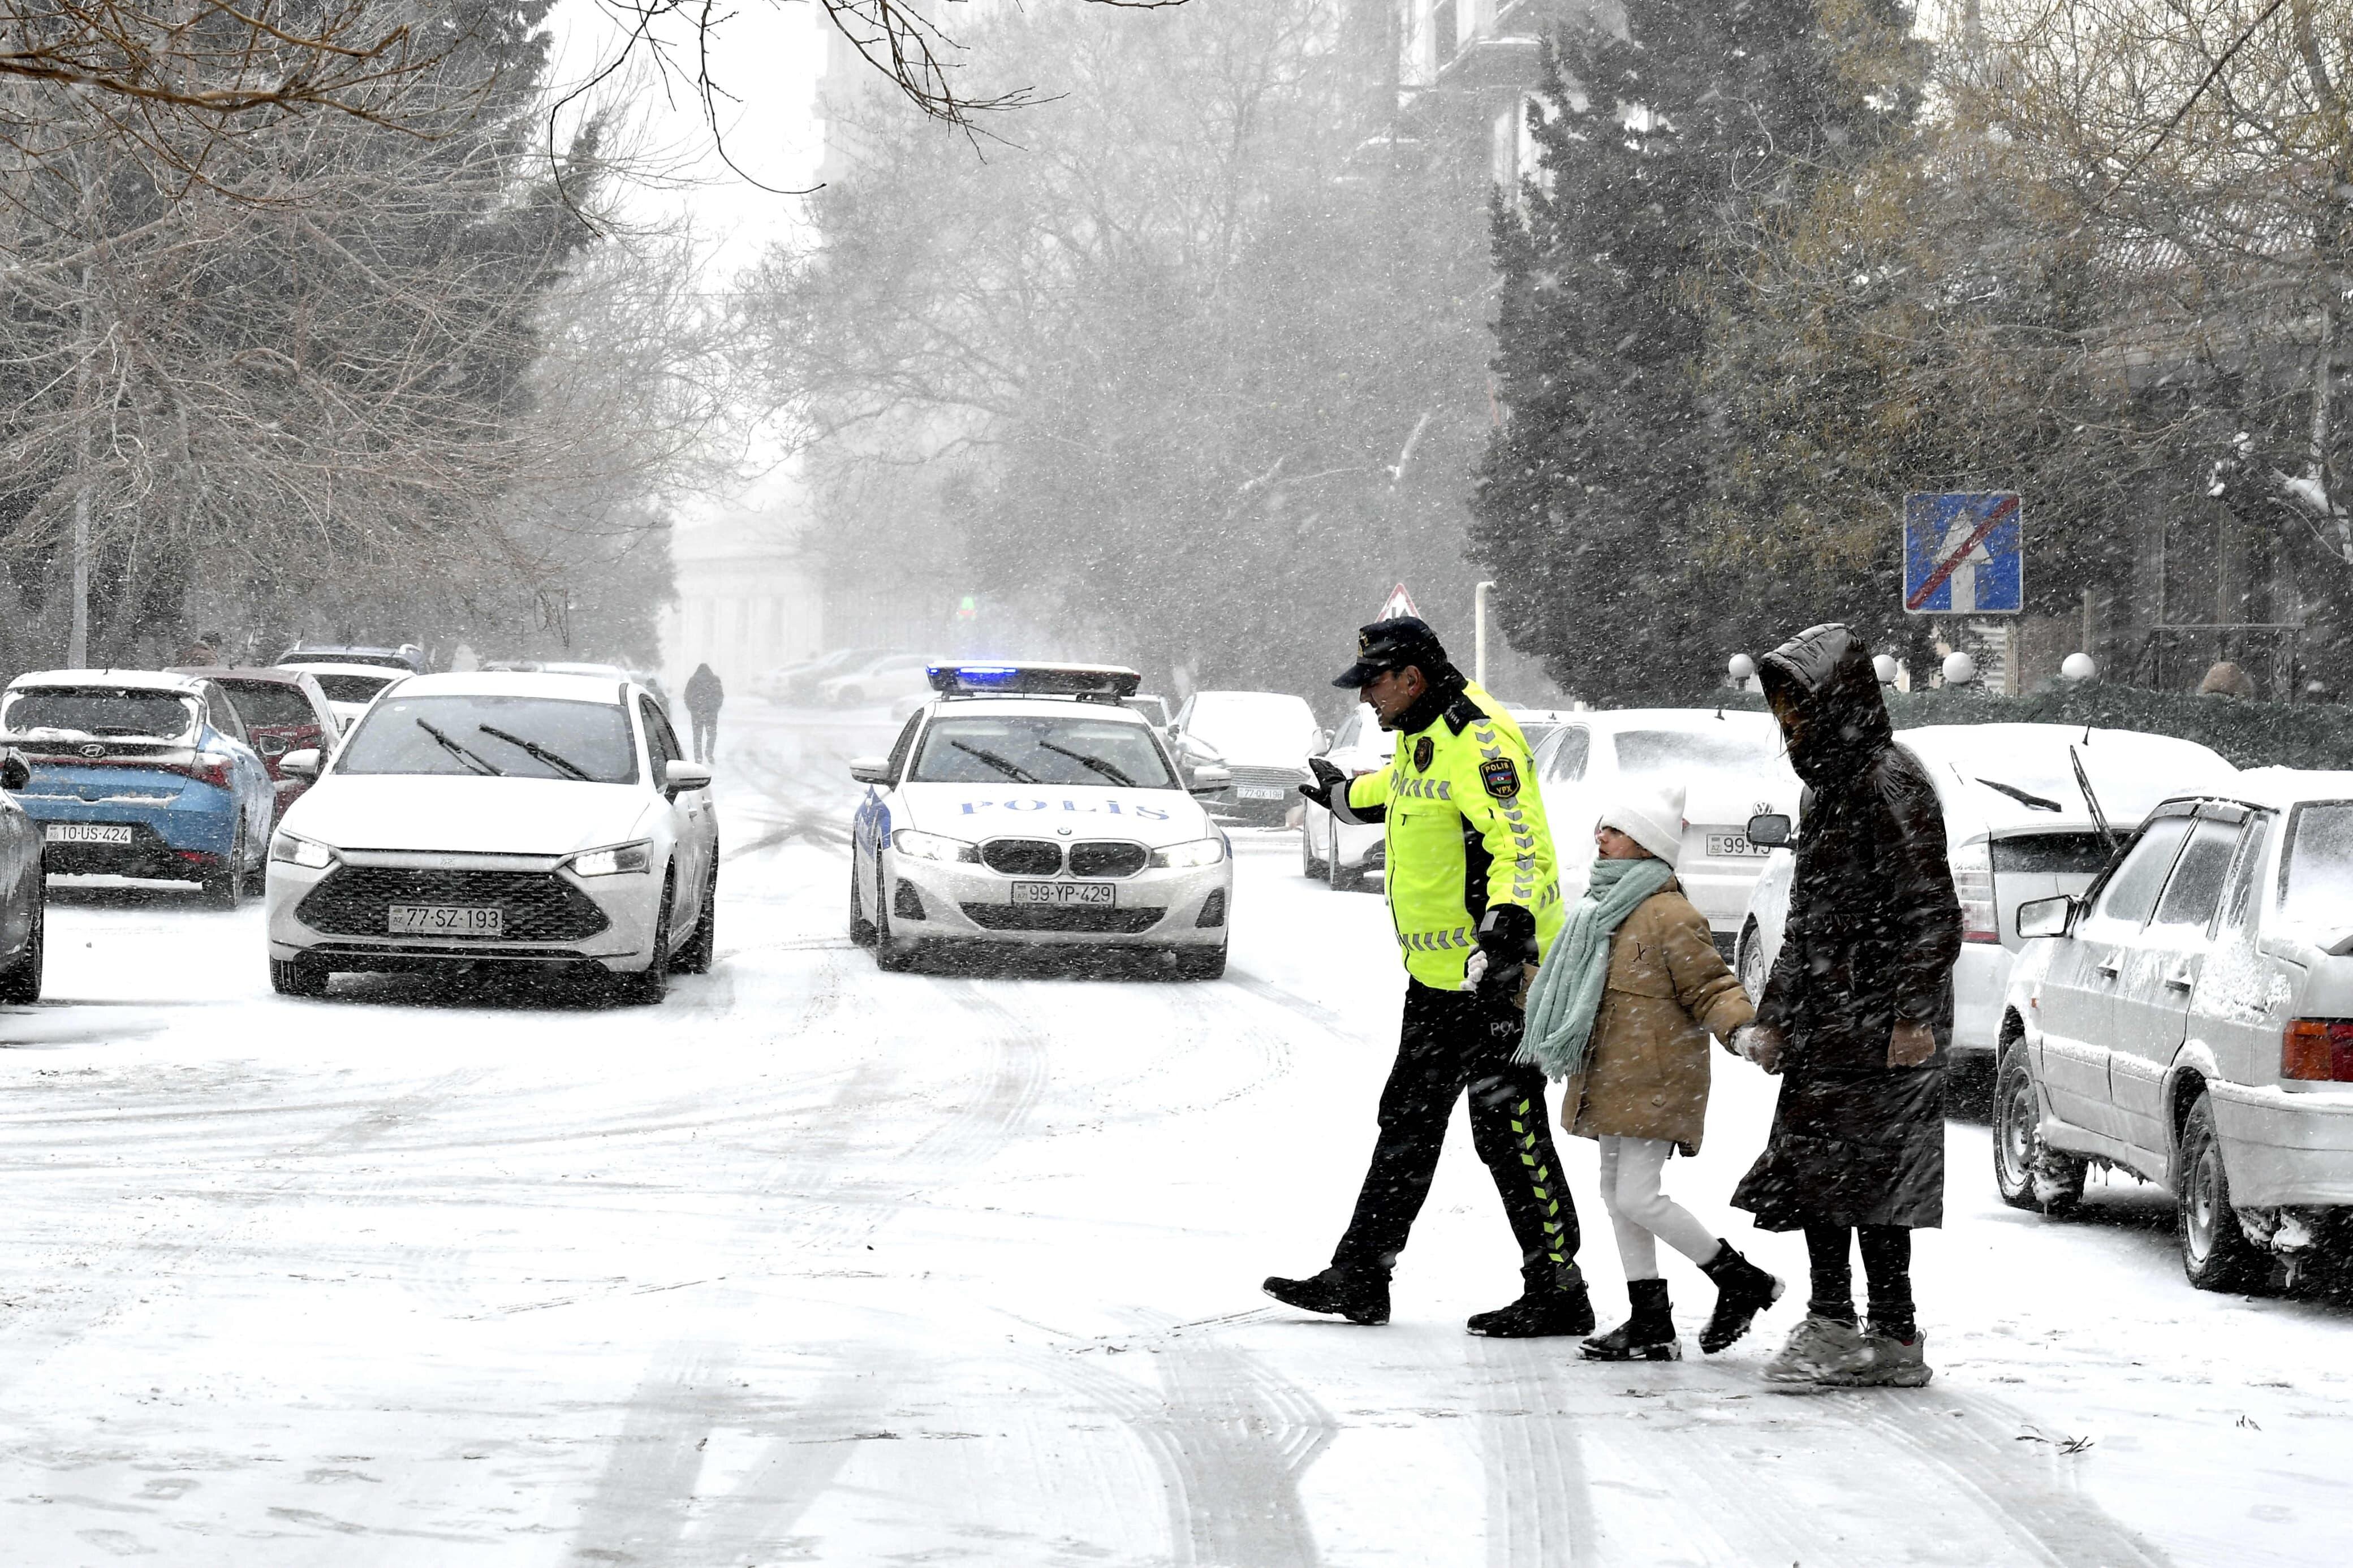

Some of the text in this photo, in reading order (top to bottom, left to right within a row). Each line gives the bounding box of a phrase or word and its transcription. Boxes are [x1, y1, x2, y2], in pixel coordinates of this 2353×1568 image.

[62, 826, 128, 842] 10-US-424
[1029, 884, 1110, 902] 99-YP-429
[406, 908, 498, 928] 77-SZ-193
